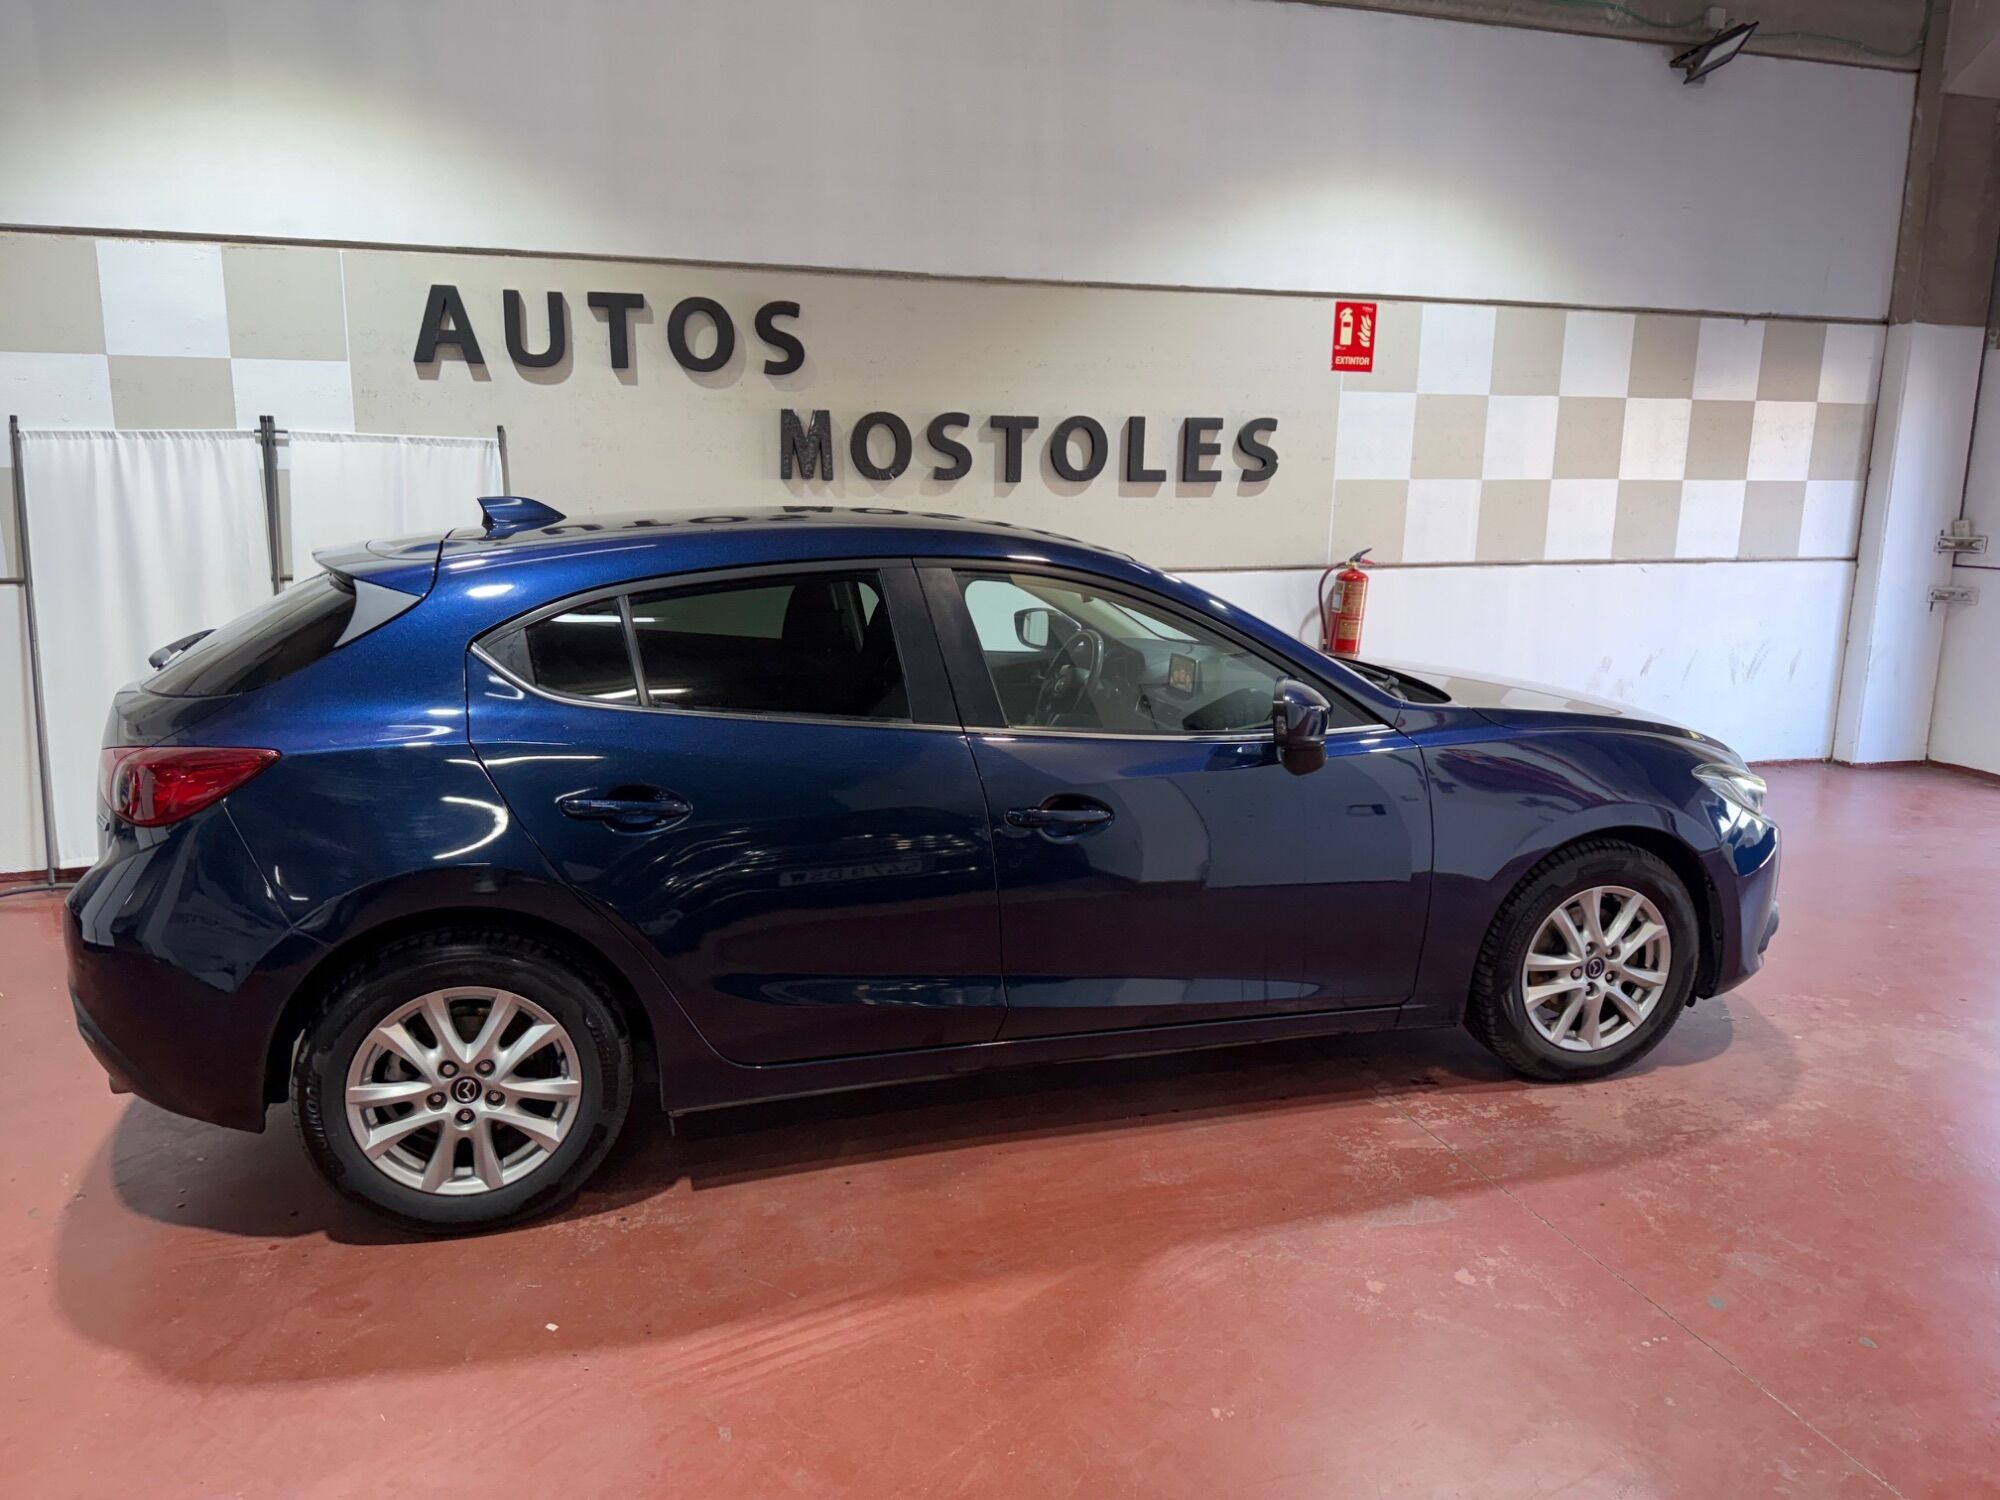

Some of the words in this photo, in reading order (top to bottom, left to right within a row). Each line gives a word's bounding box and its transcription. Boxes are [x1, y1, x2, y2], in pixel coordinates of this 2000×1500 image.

[413, 284, 806, 376] AUTOS
[1335, 355, 1370, 366] EXTINTOR
[780, 408, 1279, 484] MOSTOLES
